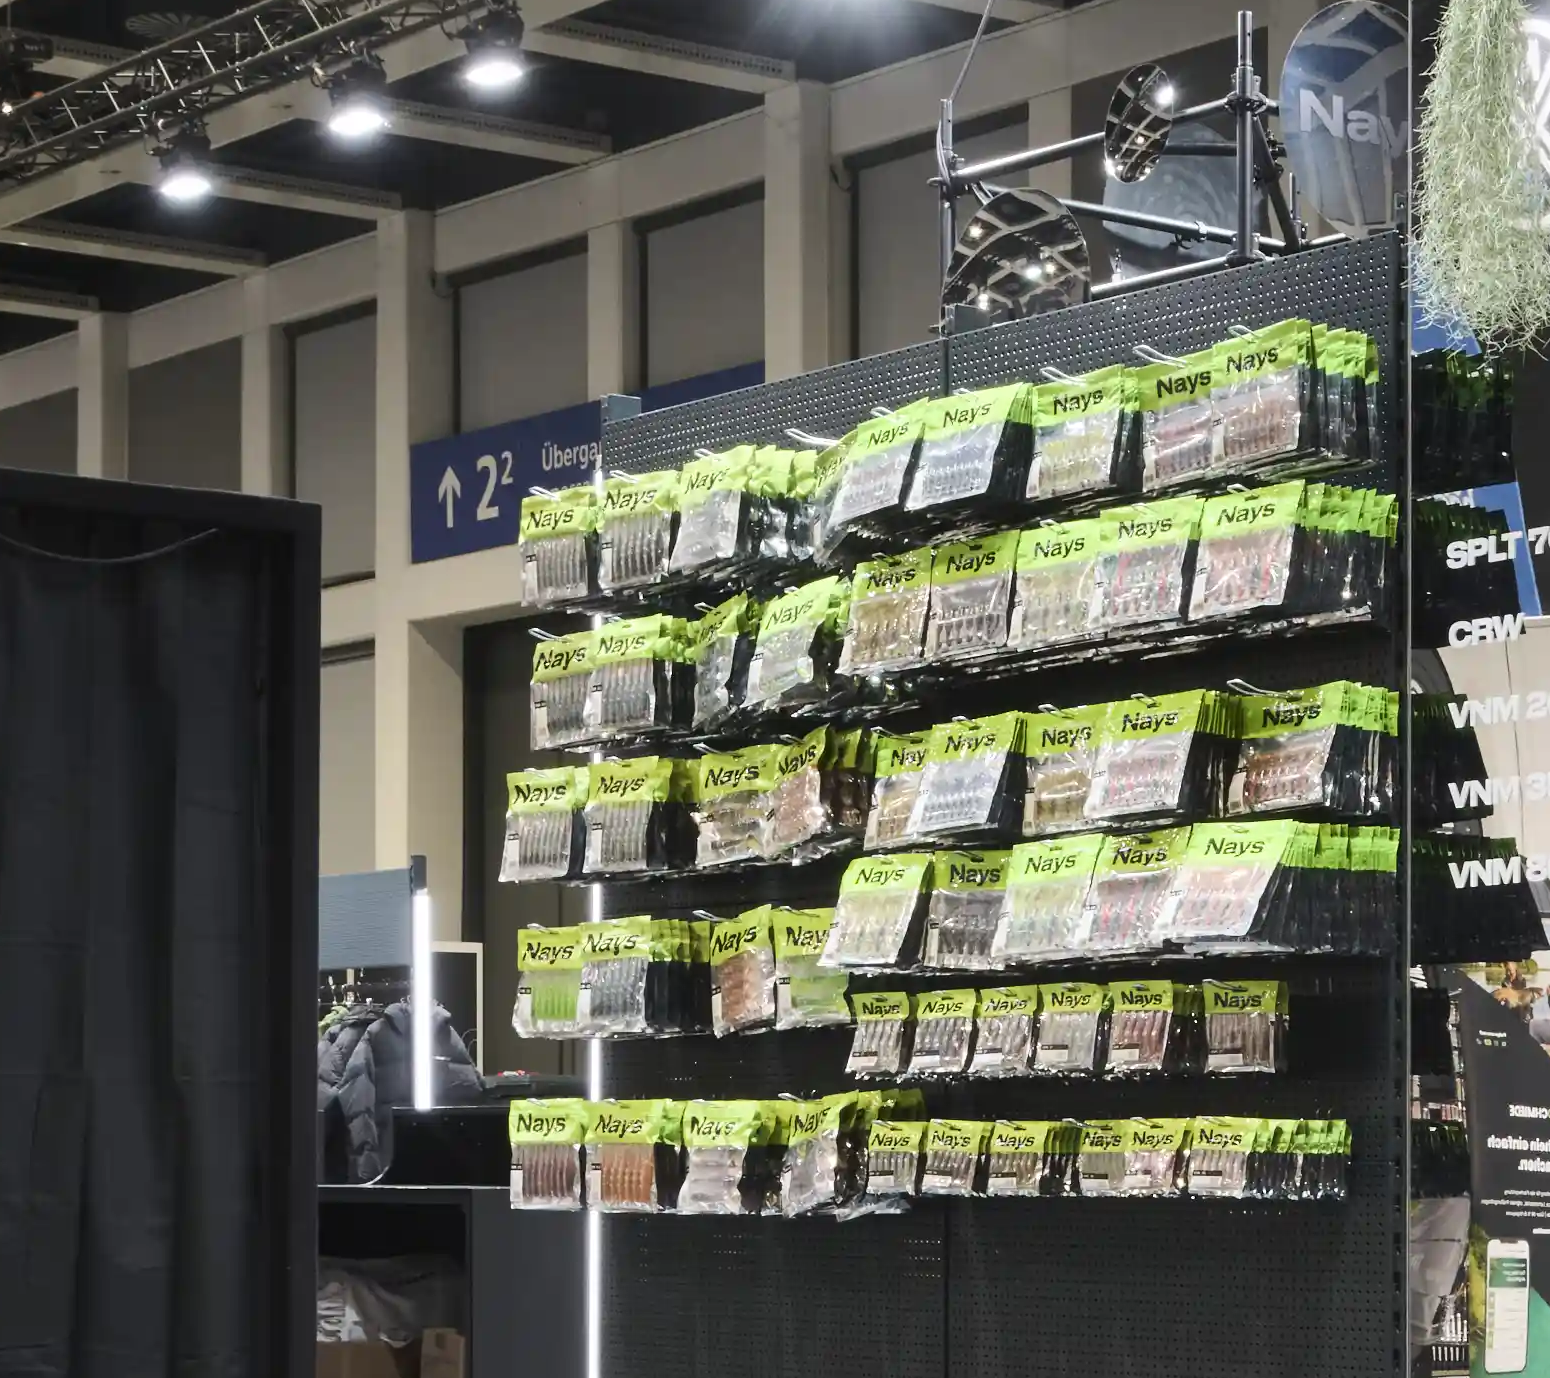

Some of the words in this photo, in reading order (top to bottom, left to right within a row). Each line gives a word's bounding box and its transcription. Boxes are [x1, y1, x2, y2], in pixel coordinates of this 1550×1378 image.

[1298, 88, 1409, 151] Nay
[1226, 348, 1280, 375] Nays
[1156, 370, 1211, 397] Nays
[1053, 390, 1103, 413] Nays
[942, 402, 991, 427] Nays
[868, 419, 910, 448] Nays
[685, 464, 732, 494] Nays
[603, 486, 657, 516] Nays
[526, 505, 575, 529] Nays
[1217, 502, 1275, 527] Nays
[1118, 516, 1173, 539] Nays
[1034, 536, 1086, 559] Nays
[1446, 531, 1522, 570] SPLT
[946, 546, 997, 578] Nays
[866, 566, 916, 589] Nays
[765, 596, 814, 628] Nays
[1448, 612, 1524, 649] CRW
[534, 645, 587, 671] Nays
[596, 633, 646, 660] Nays
[1122, 711, 1179, 735] Nays
[1262, 705, 1321, 729] Nays
[1449, 694, 1521, 730] VNM
[945, 730, 996, 754] Nays
[1041, 726, 1092, 751] Nays
[777, 743, 818, 777] Nays
[890, 749, 925, 766] Nay
[596, 776, 644, 797] Nays
[705, 763, 760, 789] Nays
[513, 782, 566, 805] Nays
[1449, 777, 1521, 810] VNM
[1112, 847, 1169, 868] Nays
[1204, 838, 1266, 860] Nays
[951, 862, 1002, 886] Nays
[1024, 852, 1078, 876] Nays
[1449, 855, 1522, 890] VNM
[856, 866, 906, 886] Nays
[582, 931, 639, 953] Nays
[712, 926, 757, 955] Nays
[786, 926, 827, 948] Nay
[523, 942, 574, 964] Nays
[861, 1001, 900, 1017] Nays
[922, 1001, 964, 1016] Nays
[984, 997, 1028, 1014] Nays
[1051, 991, 1092, 1009] Nays
[1121, 990, 1164, 1009] Nays
[1213, 991, 1263, 1011] Nays
[516, 1113, 566, 1135] Nays
[594, 1113, 645, 1136] Nays
[689, 1116, 736, 1138] Nays
[870, 1132, 911, 1148] Nays
[931, 1131, 972, 1148] Nays
[995, 1132, 1036, 1148] Nays
[1082, 1131, 1123, 1148] Nays
[1130, 1131, 1174, 1147] Nays
[1198, 1130, 1242, 1148] Nays
